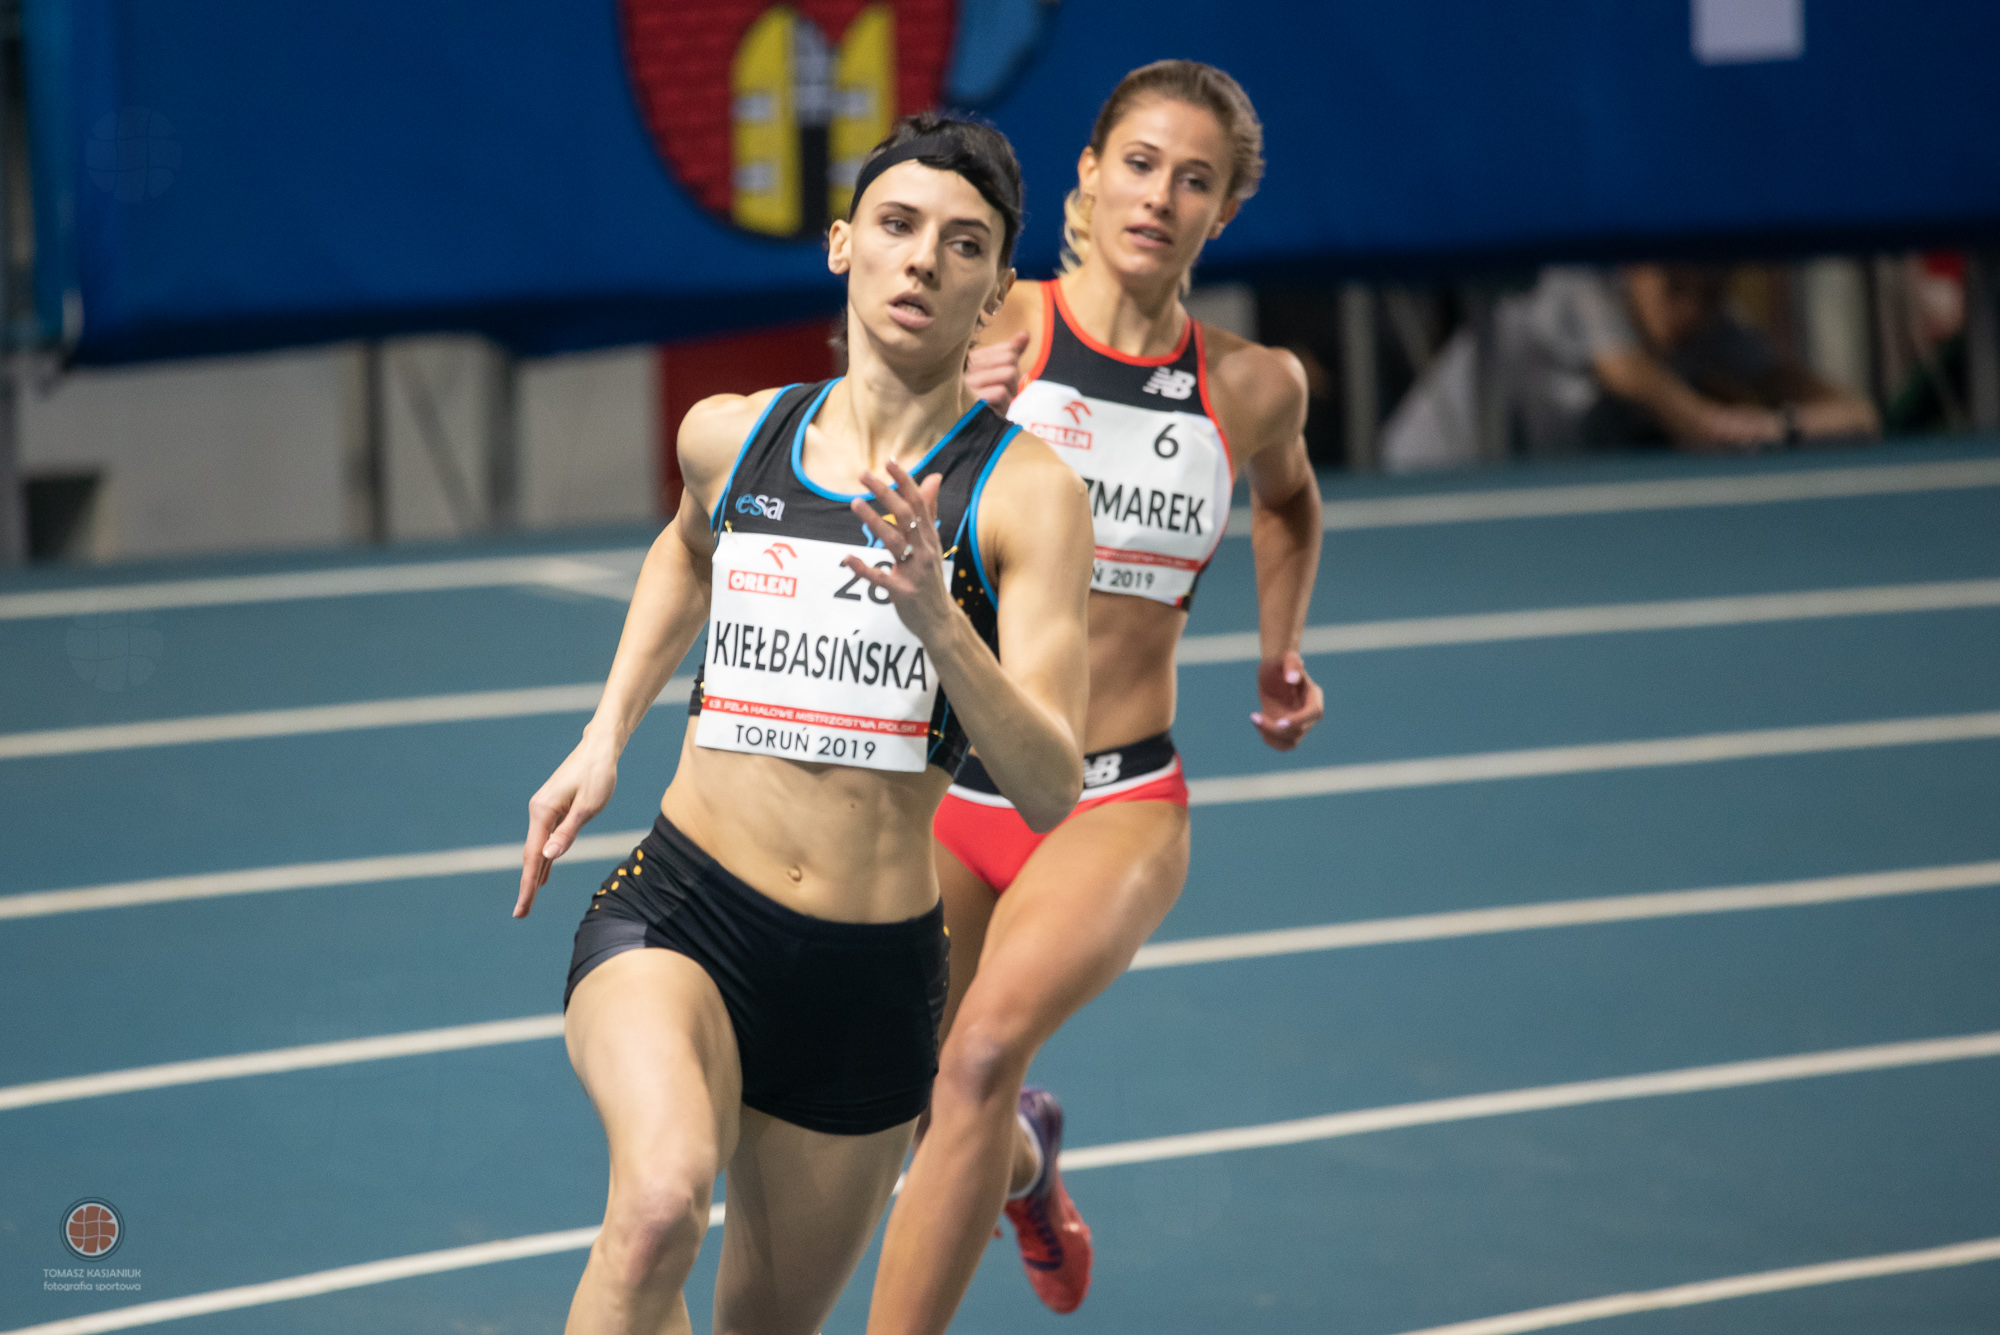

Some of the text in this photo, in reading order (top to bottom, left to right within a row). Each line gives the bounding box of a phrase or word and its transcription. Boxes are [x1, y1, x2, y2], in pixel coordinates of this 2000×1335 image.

[1031, 426, 1090, 448] ORLEN
[1154, 423, 1179, 458] 6
[730, 571, 796, 597] ORLEN
[1109, 568, 1154, 590] 2019
[713, 620, 927, 691] KIEŁBASIŃSKA
[750, 705, 794, 719] HALOWE
[795, 712, 876, 730] MISTRZOSTWA
[877, 720, 917, 734] POLSKI
[736, 724, 877, 761] TORUŃ 2019
